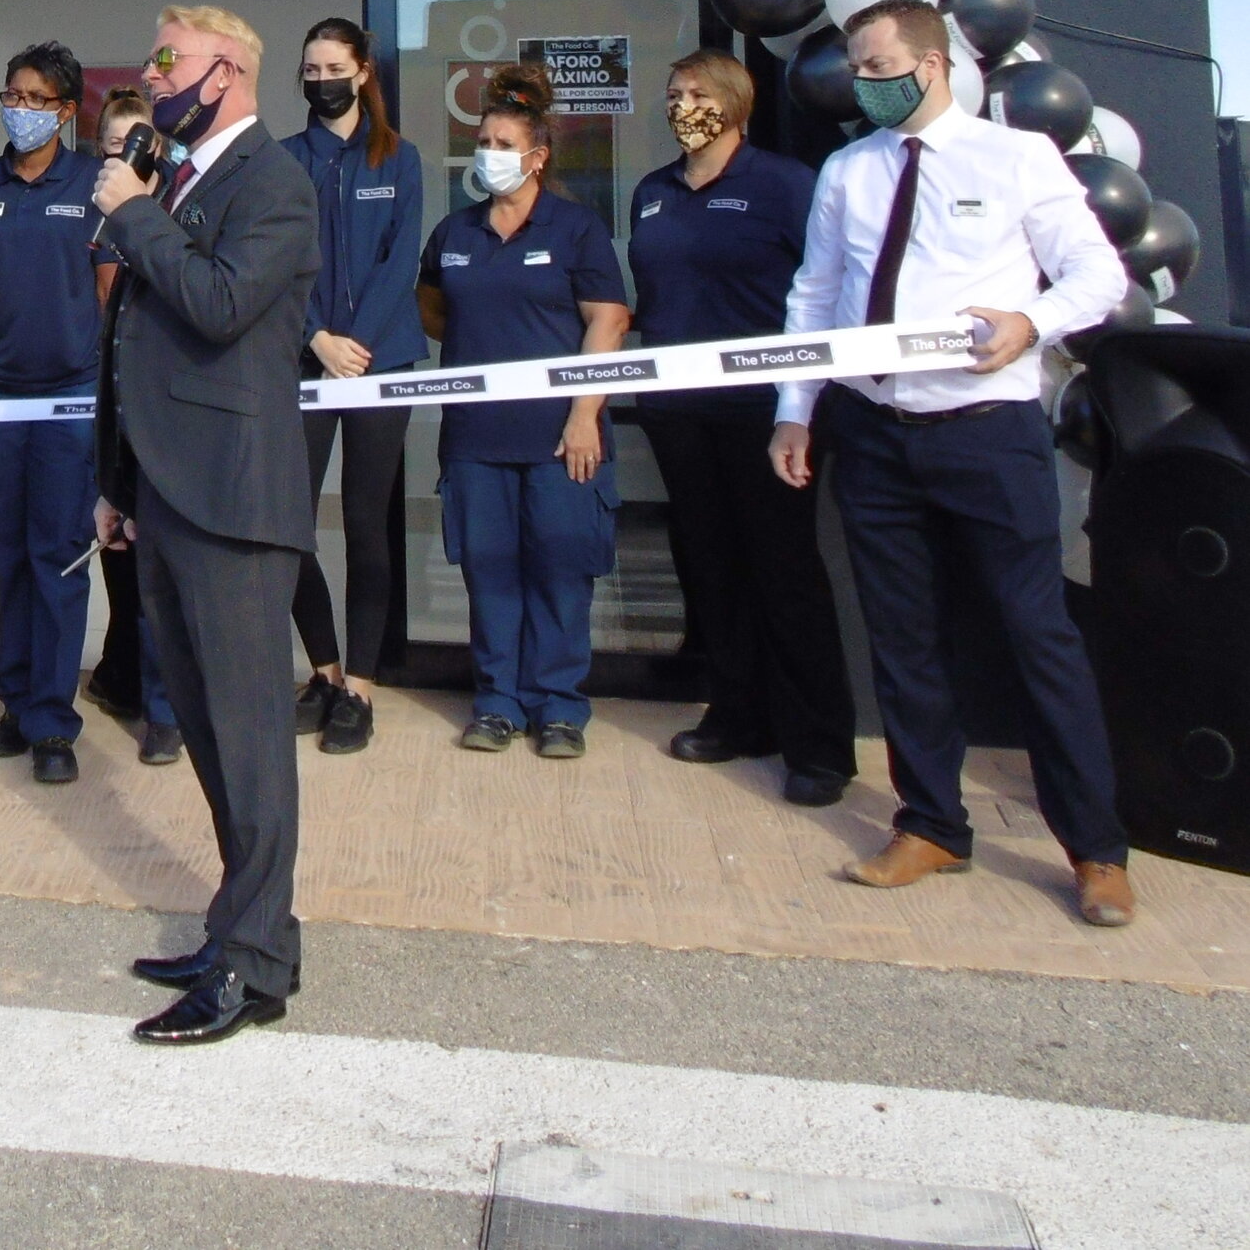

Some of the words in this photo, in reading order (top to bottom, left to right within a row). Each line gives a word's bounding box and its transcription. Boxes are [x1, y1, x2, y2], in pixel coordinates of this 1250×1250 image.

[546, 55, 602, 68] AFORO
[573, 103, 627, 111] PERSONAS
[909, 338, 936, 350] The
[939, 334, 973, 349] Food
[732, 355, 758, 366] The
[761, 351, 794, 364] Food
[797, 349, 821, 360] Co.
[559, 371, 584, 381] The
[587, 366, 619, 379] Food
[622, 366, 645, 376] Co.
[390, 386, 414, 394] The
[418, 382, 449, 392] Food
[452, 381, 475, 390] Co.
